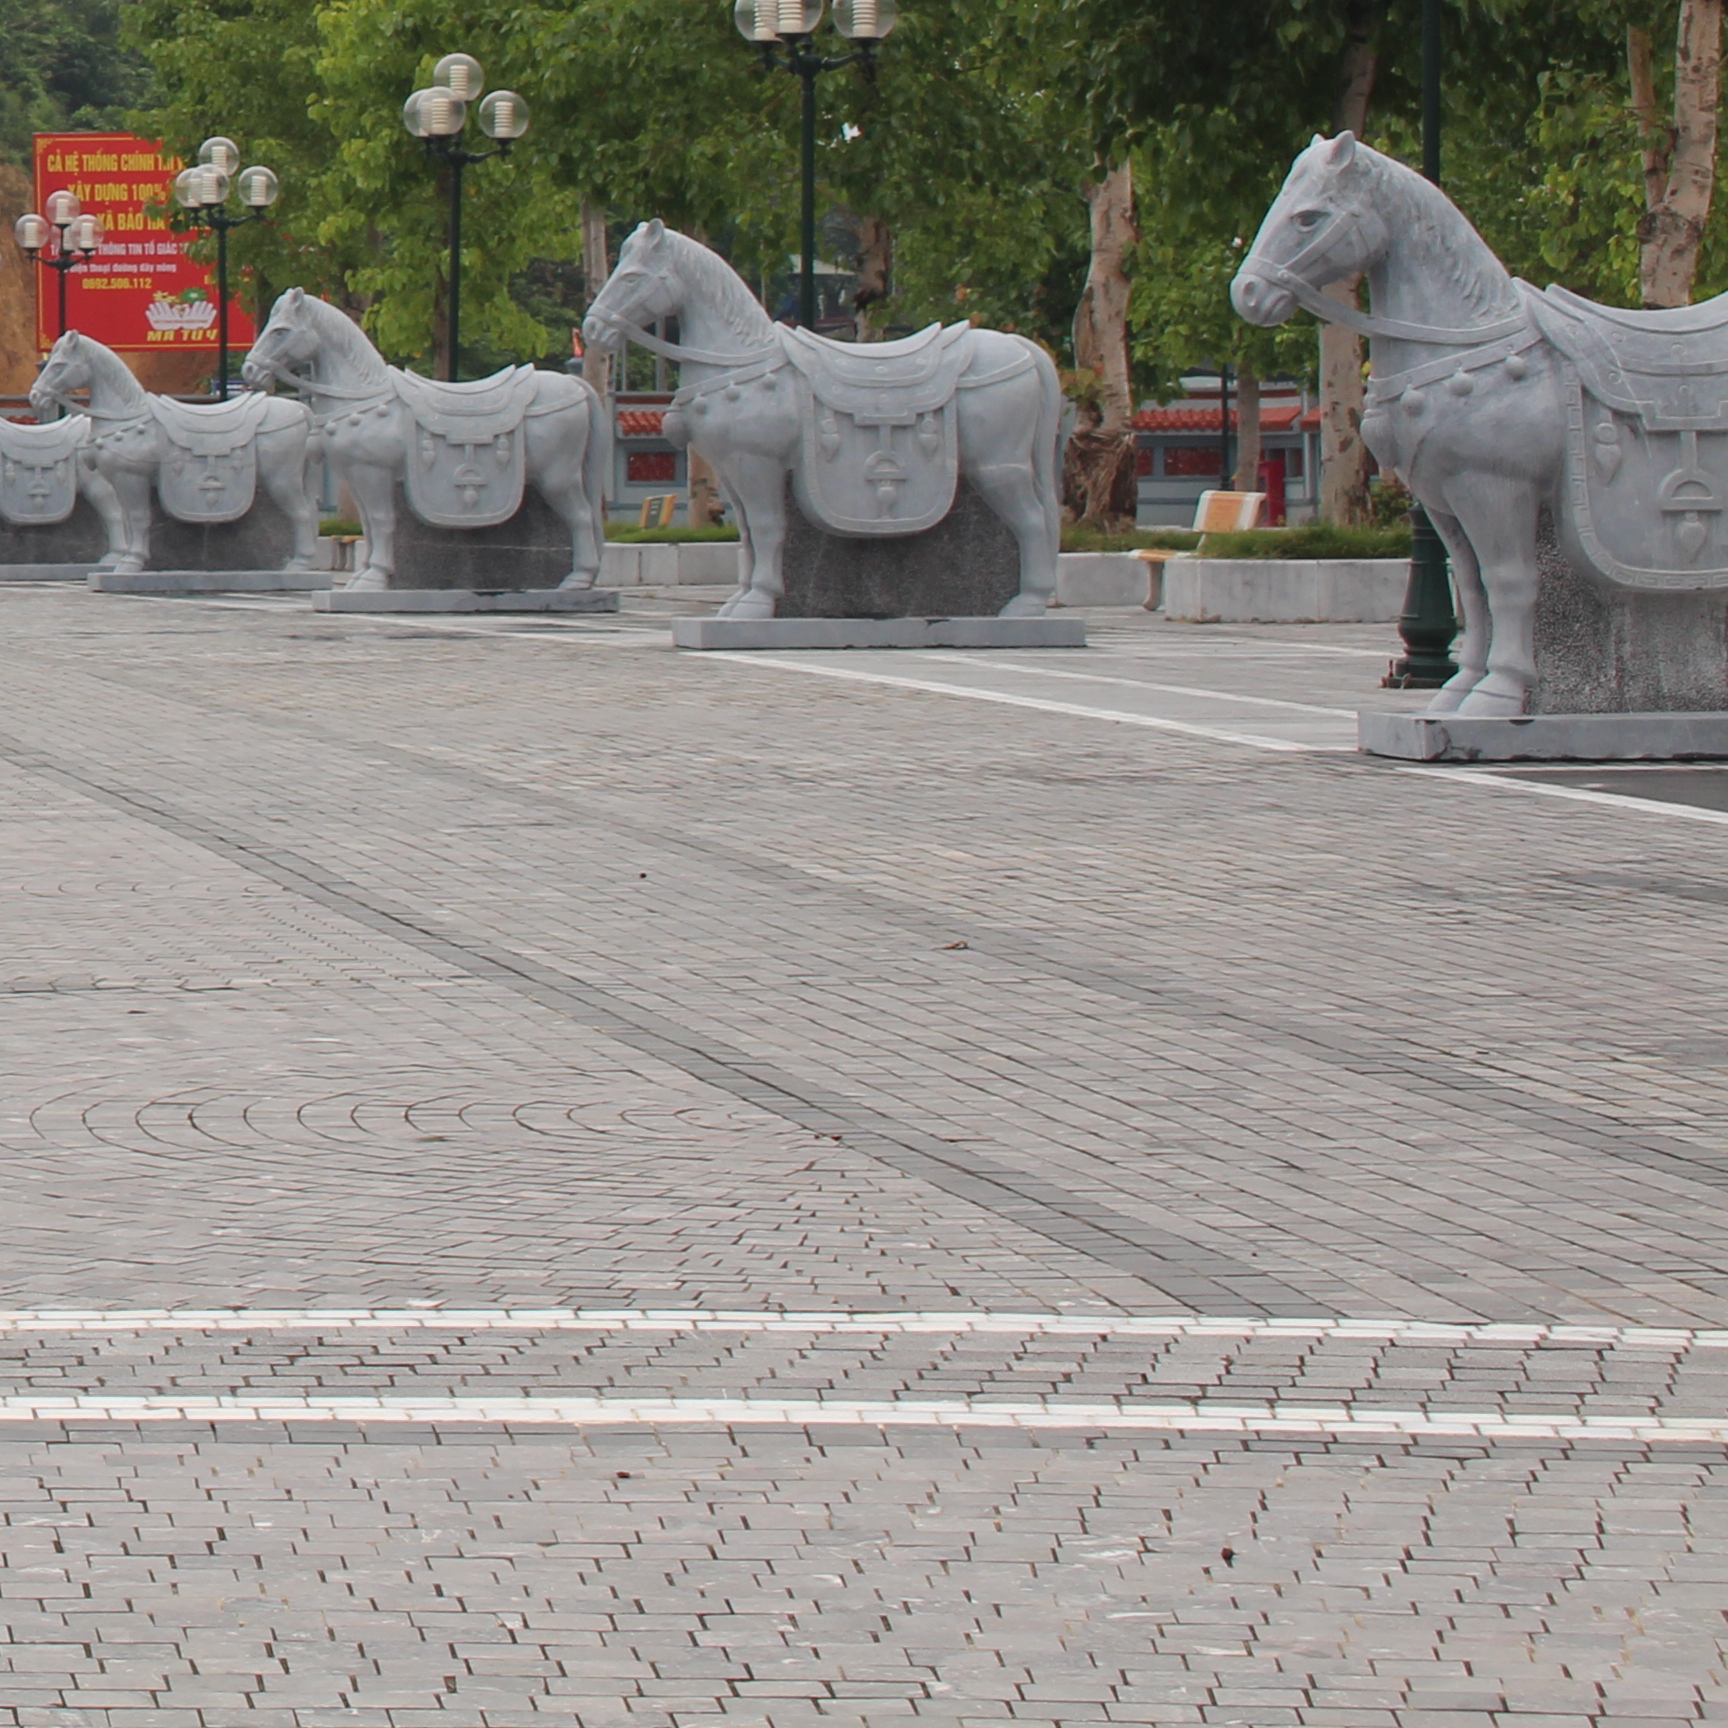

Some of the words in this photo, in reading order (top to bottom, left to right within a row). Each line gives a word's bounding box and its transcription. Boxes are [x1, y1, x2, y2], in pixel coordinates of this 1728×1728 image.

[47, 149, 63, 172] CẢ
[65, 151, 79, 176] HỆ
[82, 147, 118, 172] THỐNG
[121, 150, 155, 172] CHÍNH
[95, 182, 128, 205] DỰNG
[118, 207, 144, 231] BẢO
